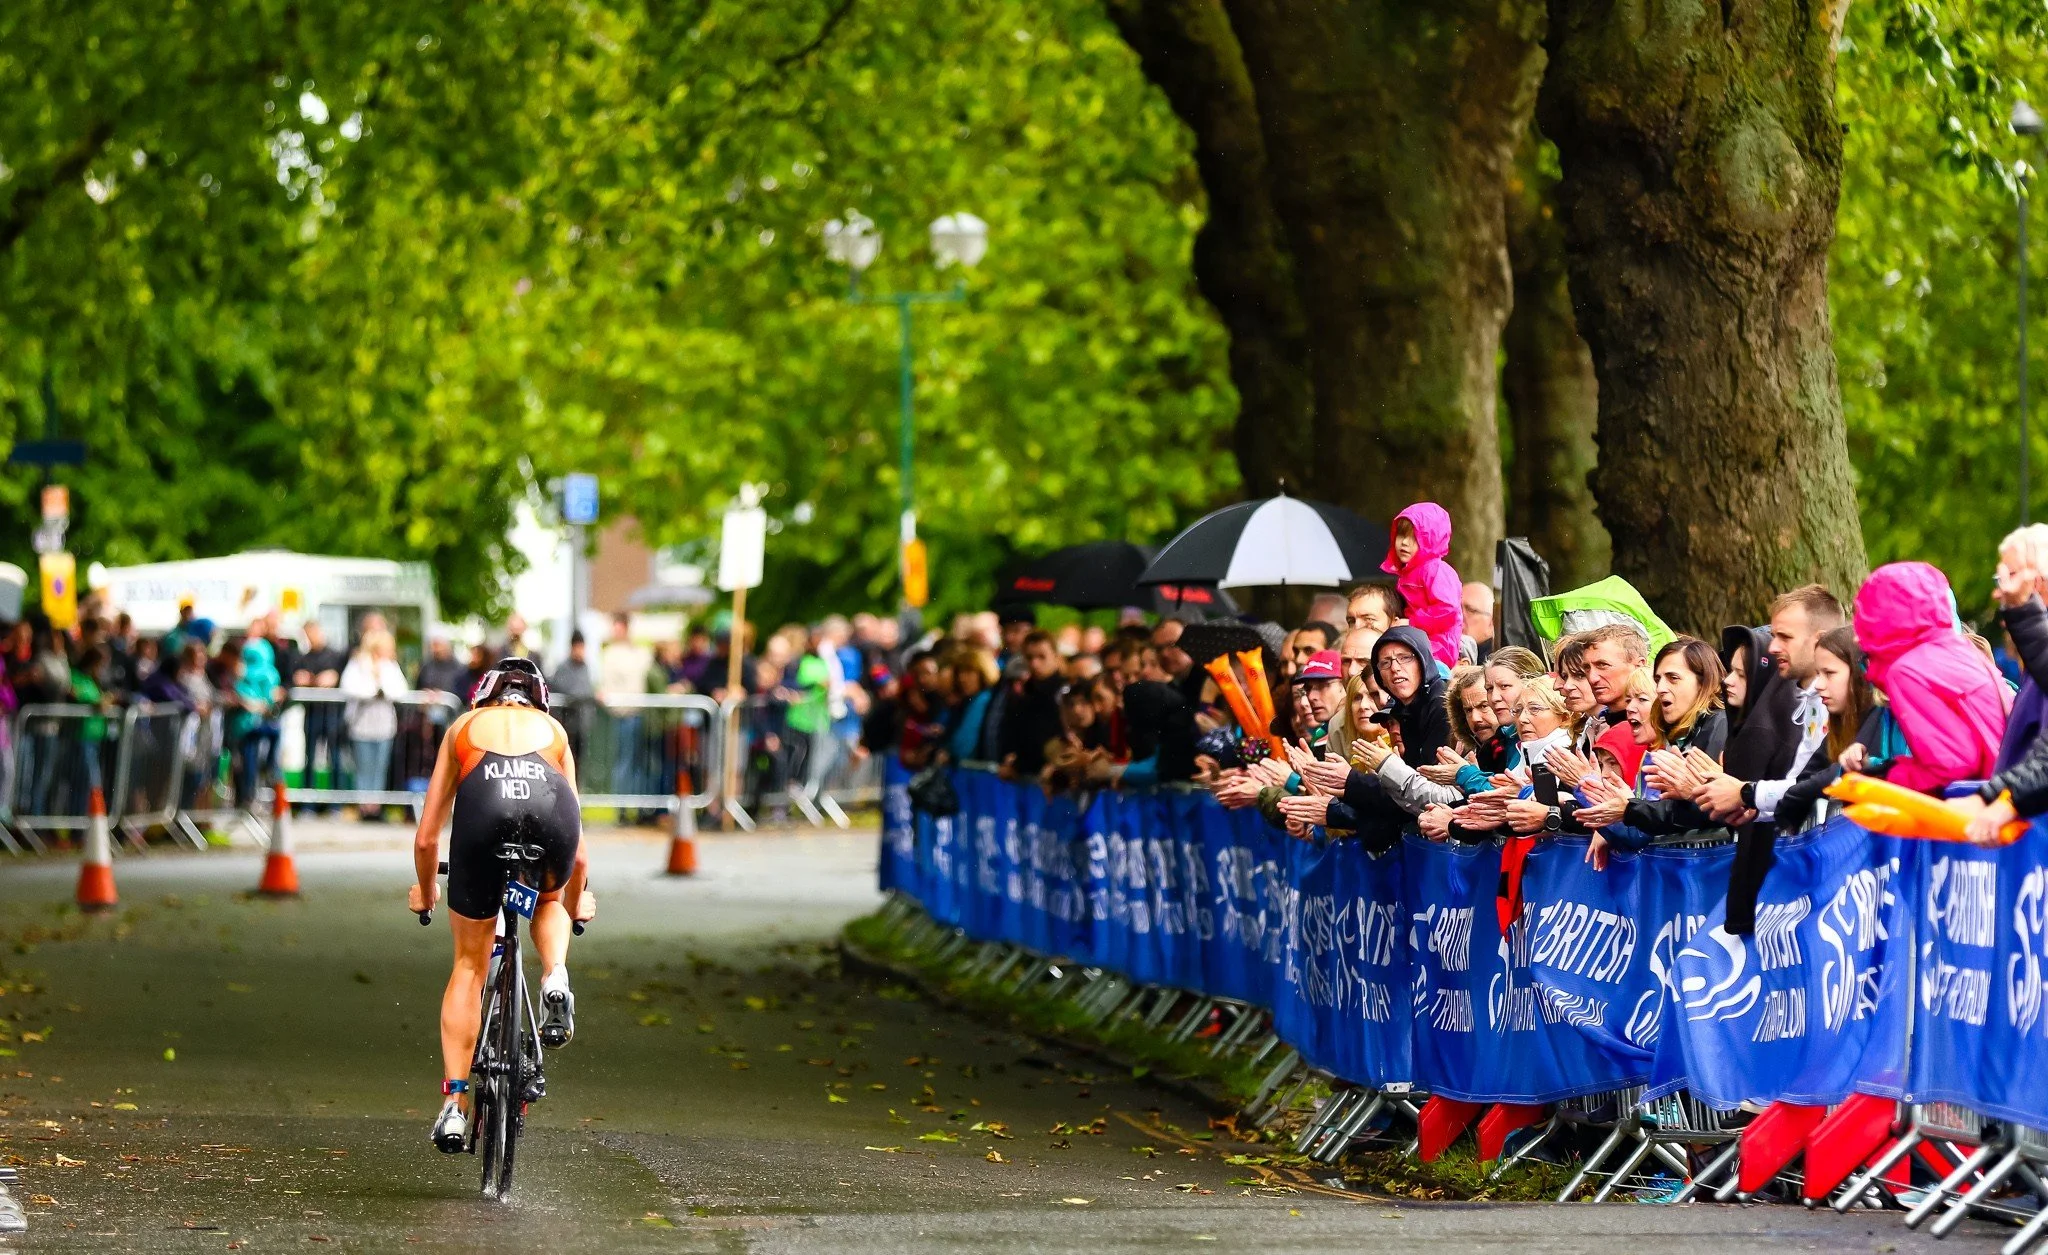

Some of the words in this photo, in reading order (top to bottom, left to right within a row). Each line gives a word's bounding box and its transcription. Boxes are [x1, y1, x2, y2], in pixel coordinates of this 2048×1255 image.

[484, 759, 547, 782] KLAMER
[501, 779, 531, 800] NED
[1533, 901, 1637, 985] BRITISH
